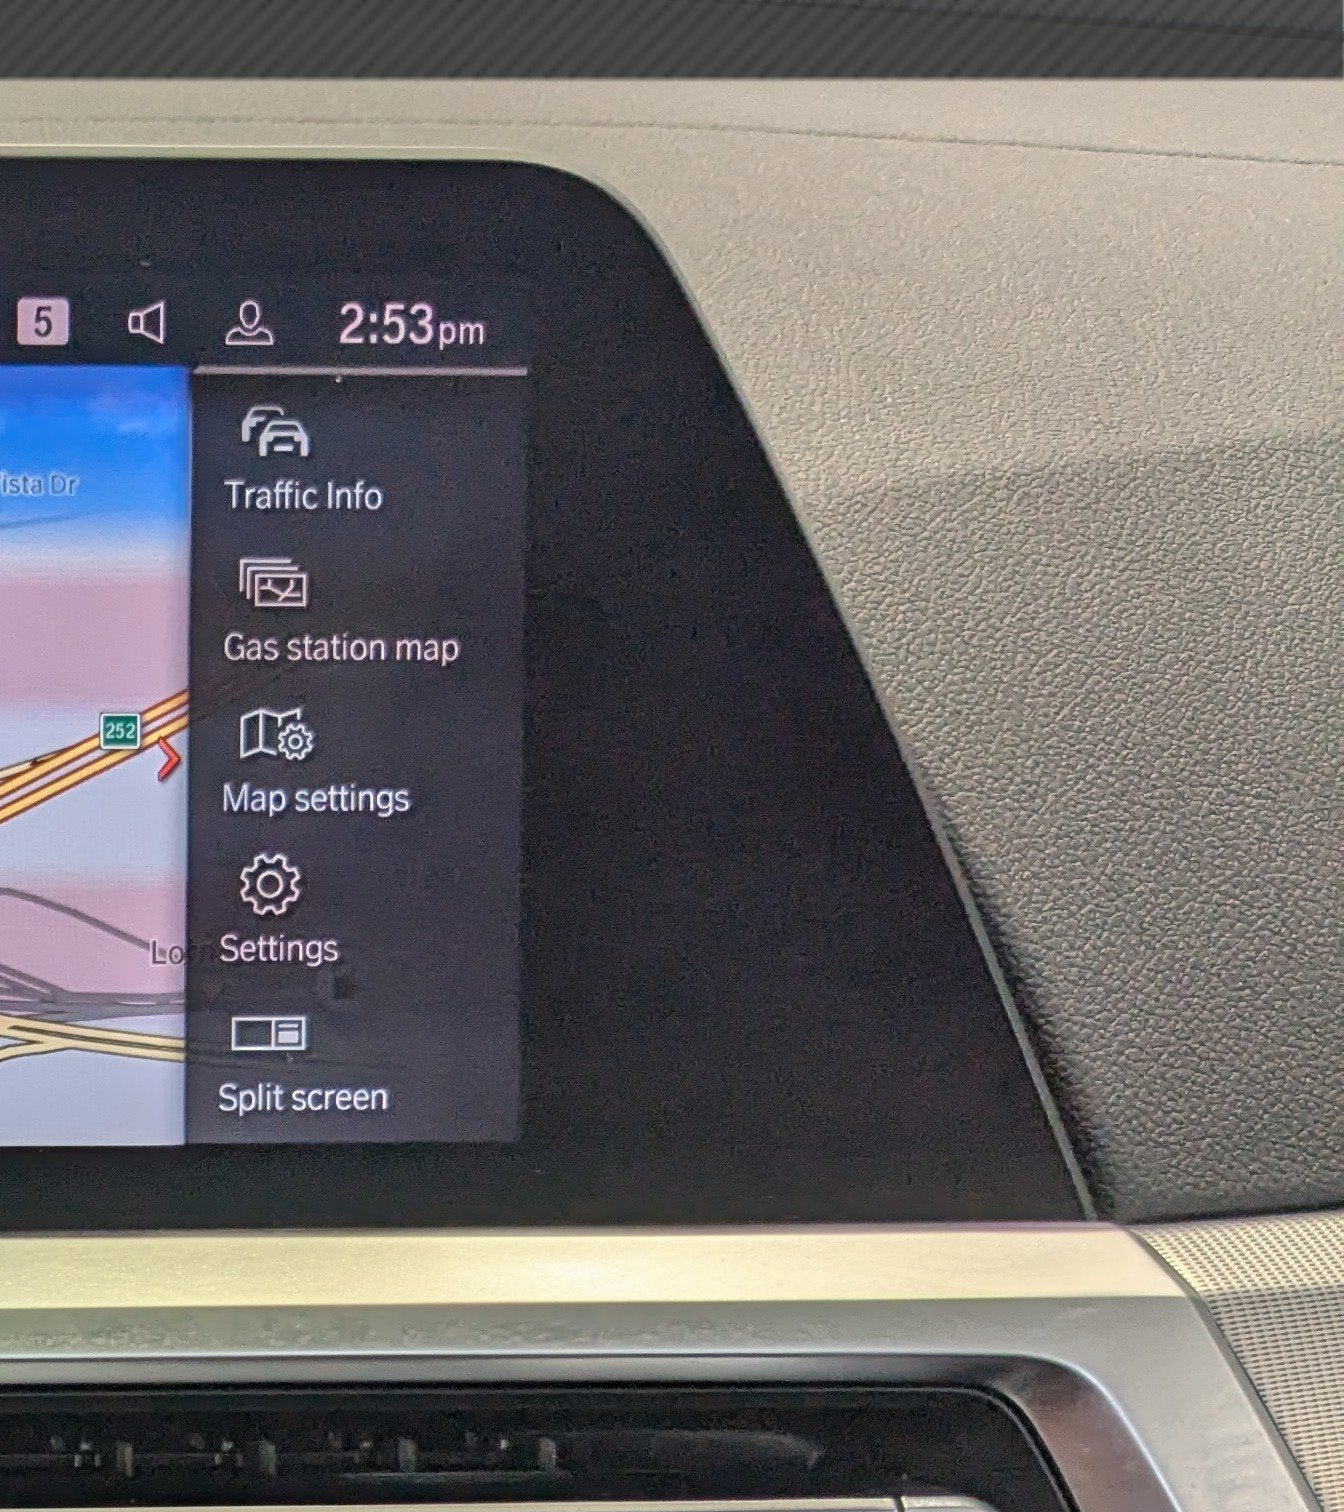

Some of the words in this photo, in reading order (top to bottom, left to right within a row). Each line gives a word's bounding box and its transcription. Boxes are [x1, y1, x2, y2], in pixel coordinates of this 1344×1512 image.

[35, 308, 53, 337] 5
[51, 473, 79, 496] Dr
[225, 480, 317, 510] Traffic
[327, 480, 384, 510] Info
[224, 633, 279, 662] Gas
[287, 633, 385, 662] station
[396, 638, 460, 666] map
[105, 722, 136, 742] 252
[223, 784, 286, 815] Map
[295, 785, 410, 818] settings
[219, 935, 339, 967] Settings
[219, 1084, 284, 1117] Split
[292, 1087, 389, 1112] screen
